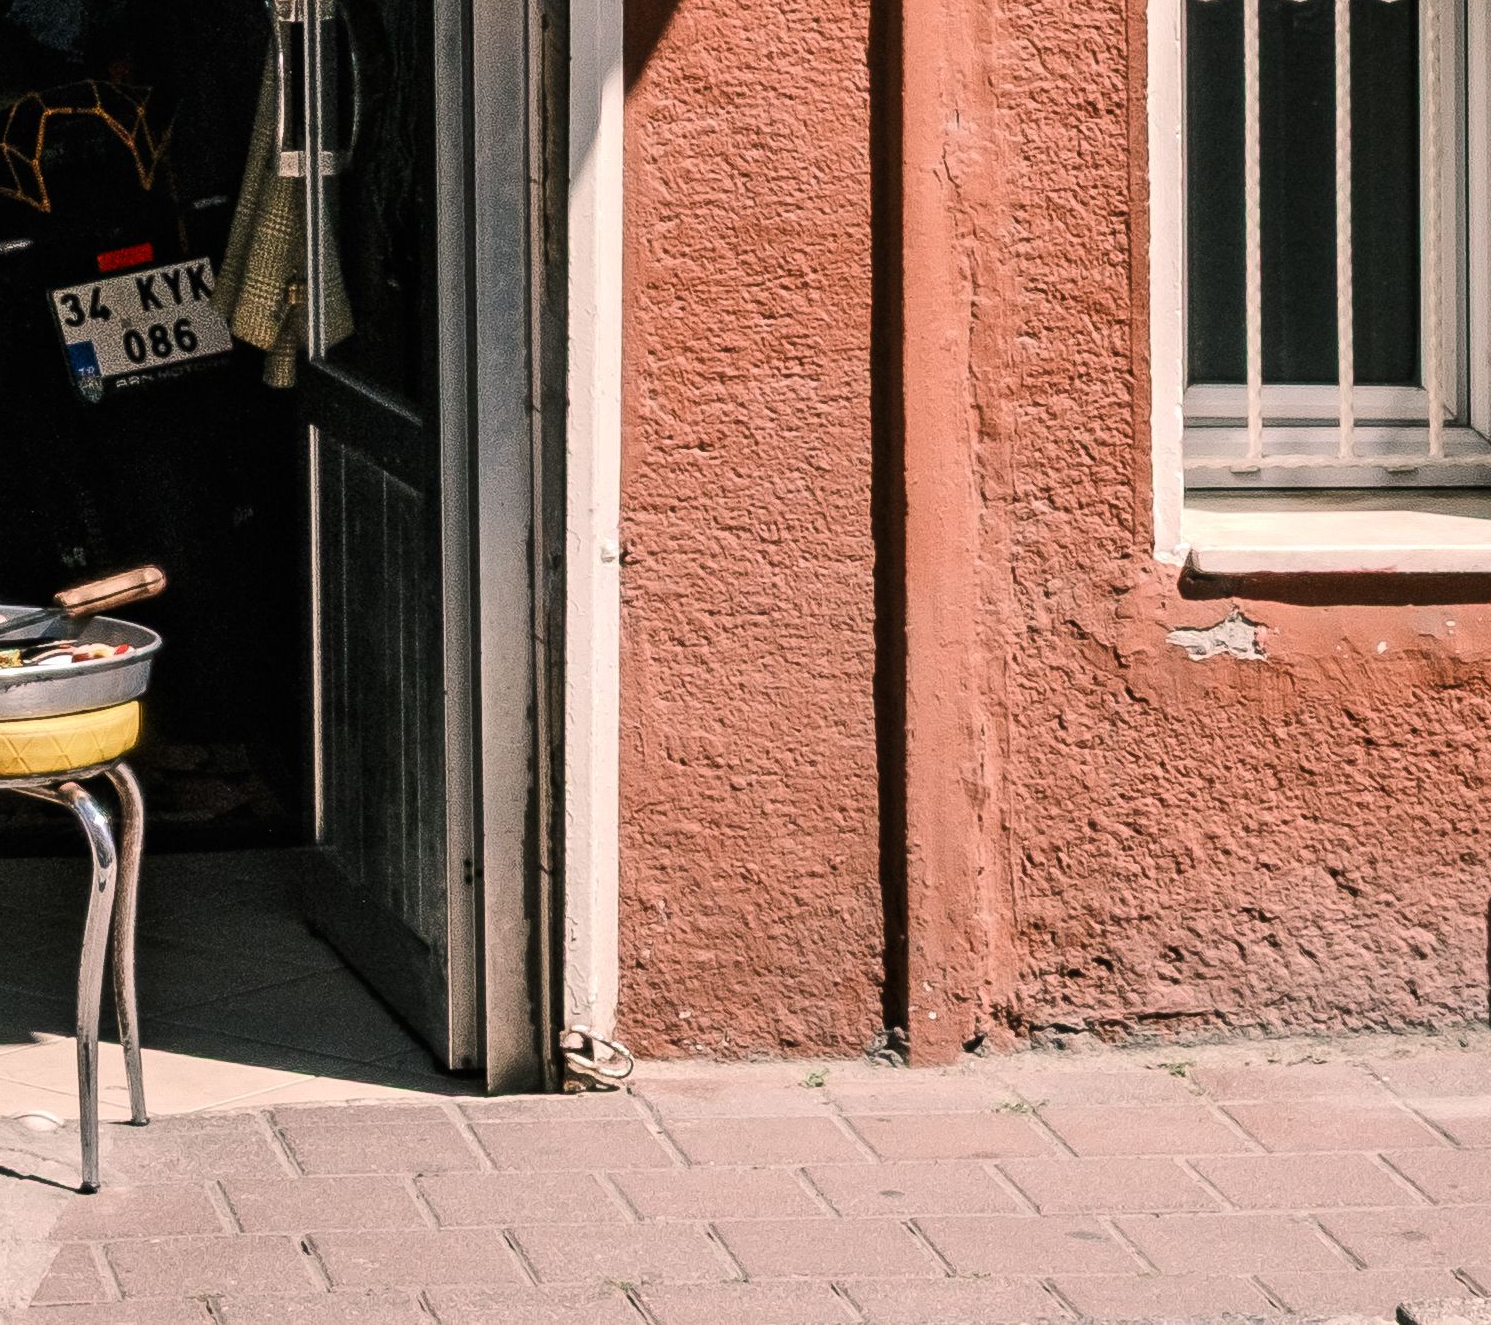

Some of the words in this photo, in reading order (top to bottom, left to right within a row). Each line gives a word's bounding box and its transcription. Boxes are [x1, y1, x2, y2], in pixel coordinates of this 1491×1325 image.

[60, 286, 111, 328] 34
[135, 263, 213, 312] KYK
[122, 318, 198, 364] 086
